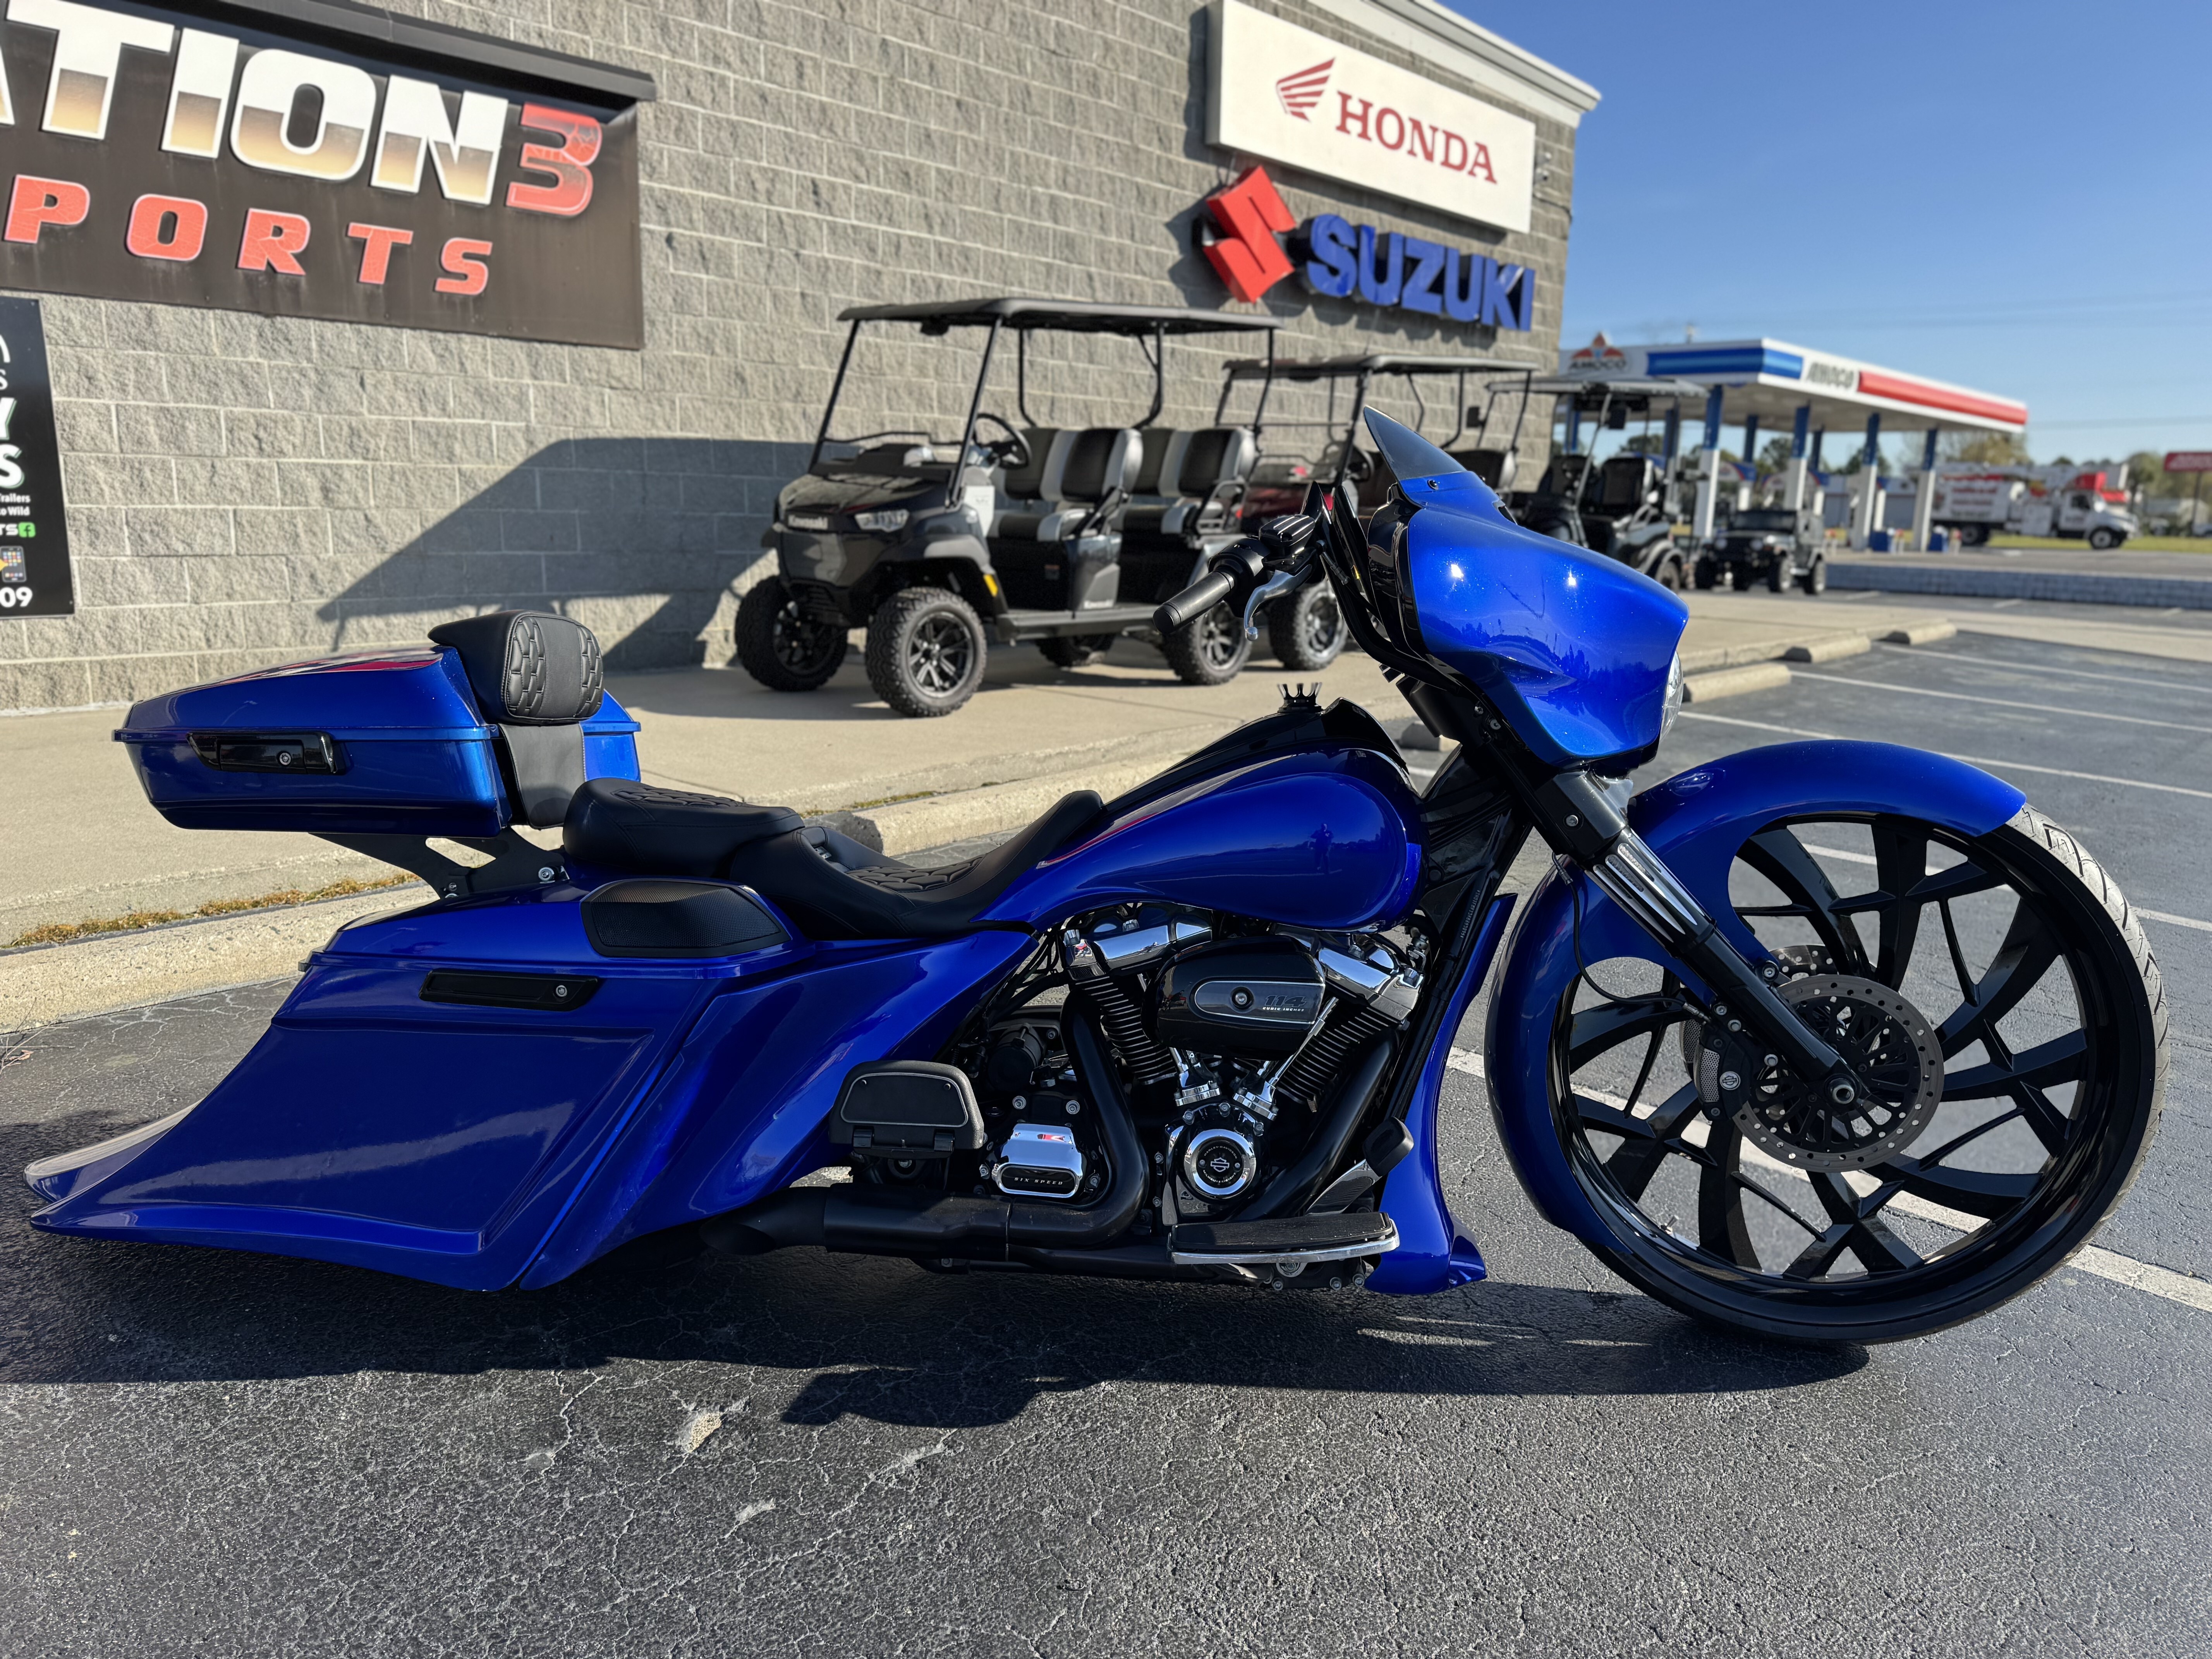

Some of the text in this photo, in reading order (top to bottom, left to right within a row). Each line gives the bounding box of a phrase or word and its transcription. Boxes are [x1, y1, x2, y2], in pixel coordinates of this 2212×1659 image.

[1336, 90, 1498, 184] HONDA
[1307, 213, 1535, 332] SUZUKI
[7, 506, 30, 516] Wild
[788, 514, 828, 530] Kawasaki
[1264, 995, 1307, 1007] 114
[1204, 1146, 1237, 1159] HARLEY-DAVIDSON
